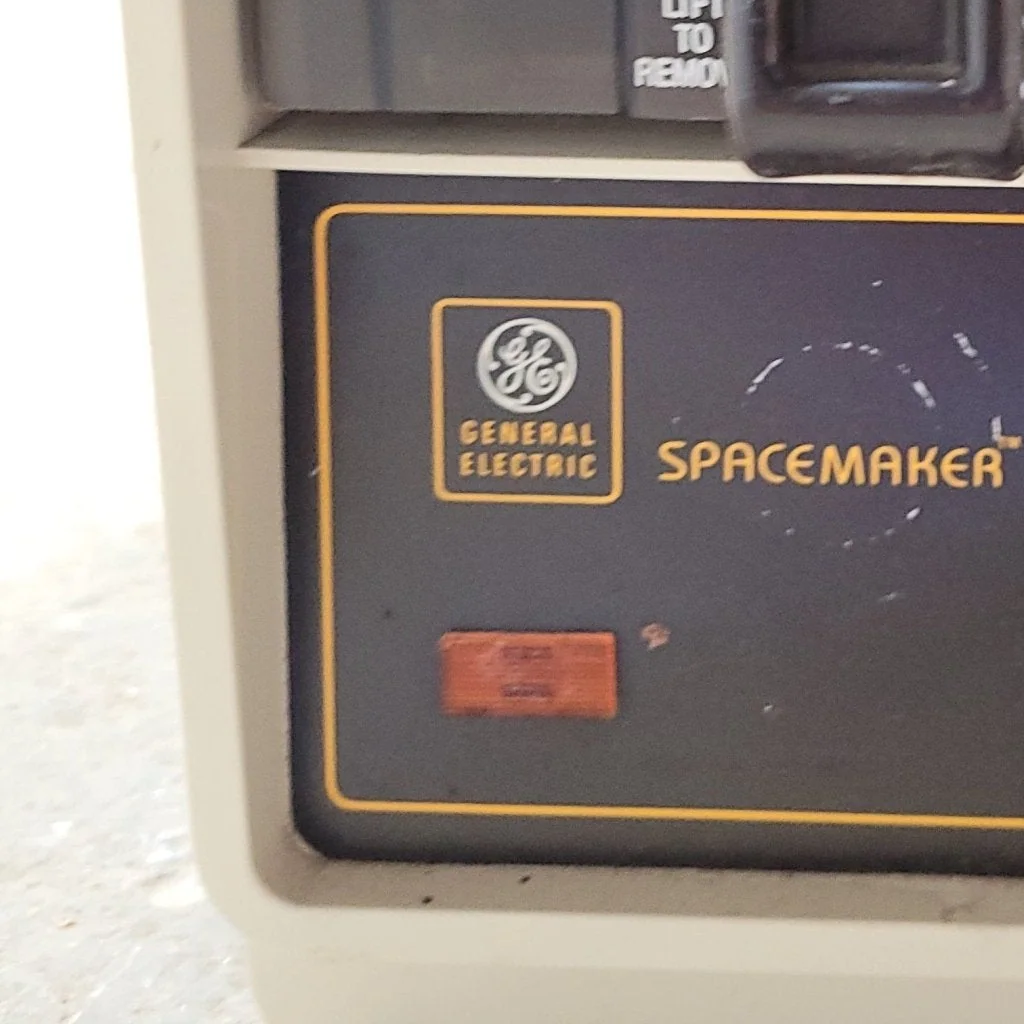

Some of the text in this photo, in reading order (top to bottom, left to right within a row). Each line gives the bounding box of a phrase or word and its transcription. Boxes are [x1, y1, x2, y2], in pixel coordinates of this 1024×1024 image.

[671, 22, 715, 54] TO
[458, 419, 596, 447] GENERAL
[458, 451, 598, 479] ELECTRIC
[657, 439, 1004, 489] SPACEMAKER
